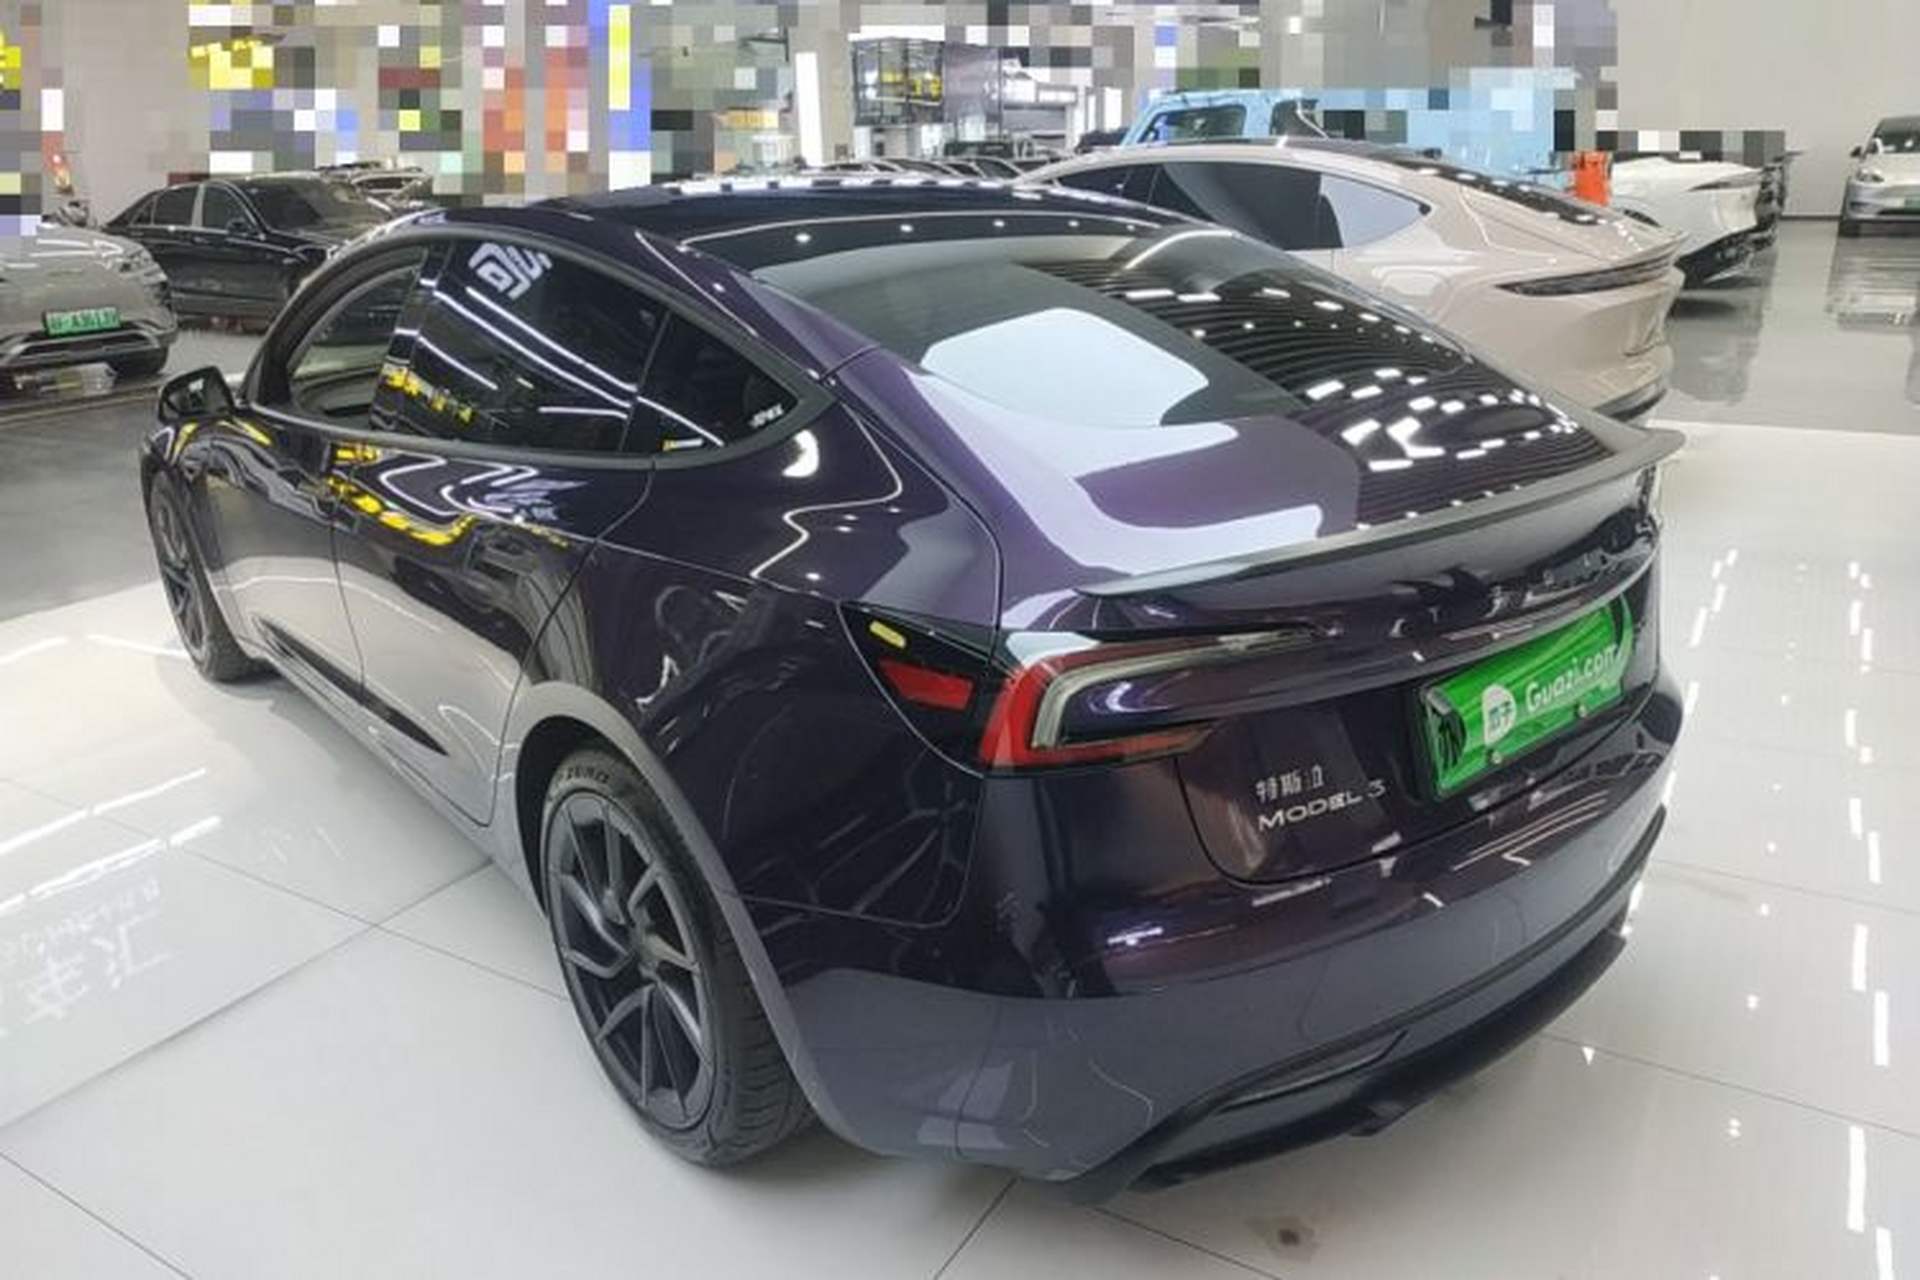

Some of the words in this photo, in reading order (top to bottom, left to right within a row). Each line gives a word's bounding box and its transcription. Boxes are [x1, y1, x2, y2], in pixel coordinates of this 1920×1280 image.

[1526, 644, 1621, 712] Guazi.com
[1258, 791, 1363, 831] MODEL
[1367, 779, 1387, 798] 3
